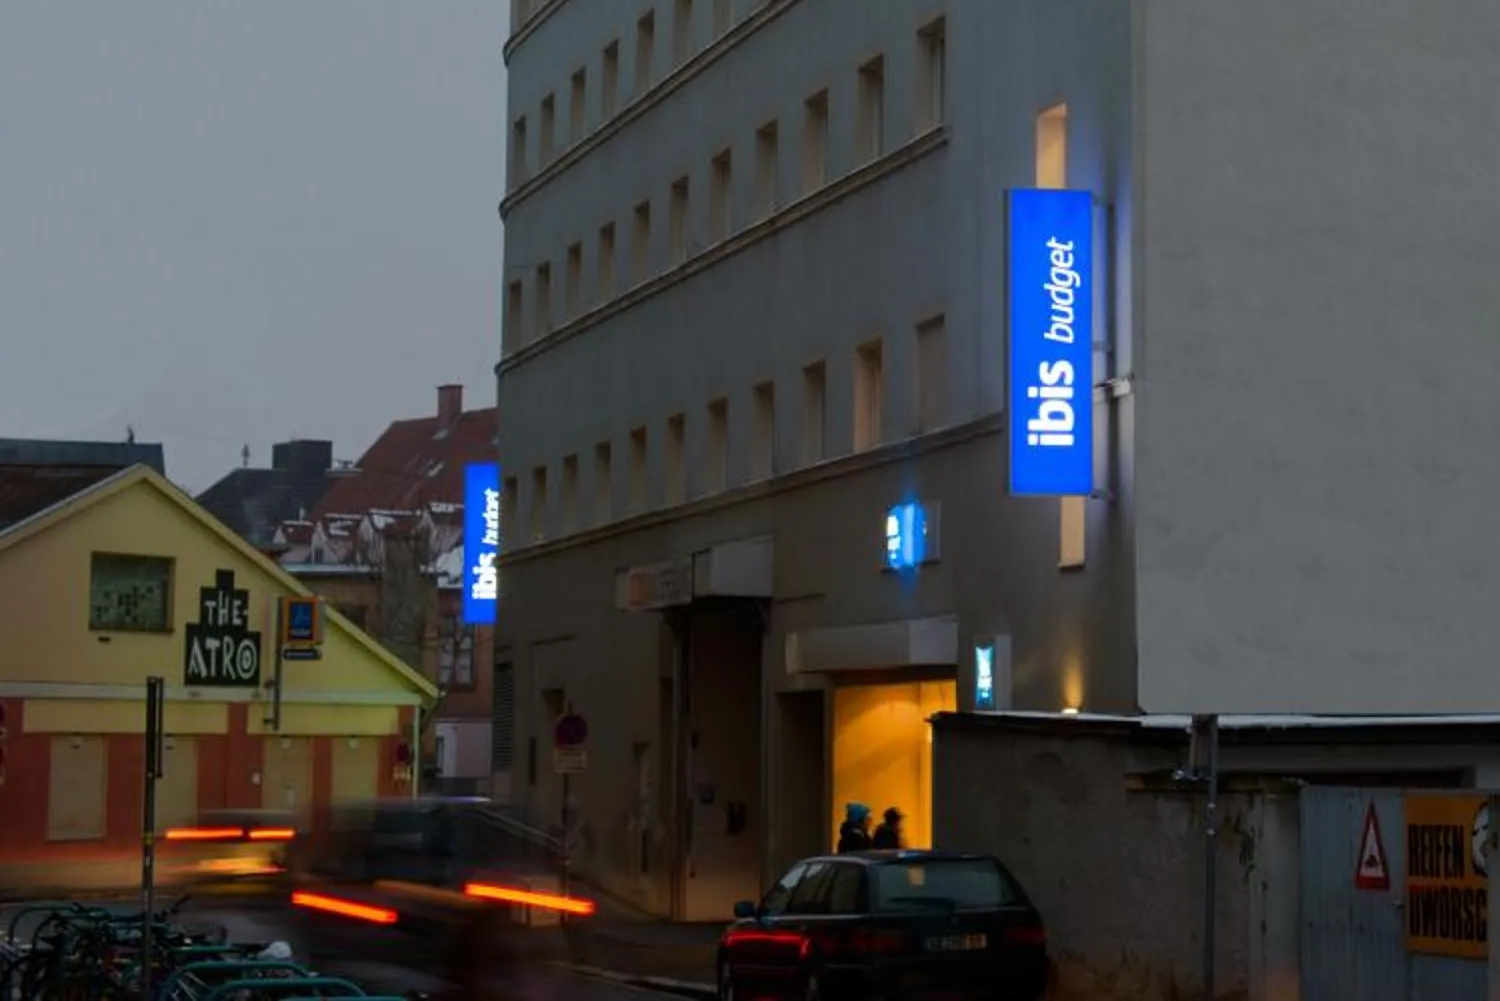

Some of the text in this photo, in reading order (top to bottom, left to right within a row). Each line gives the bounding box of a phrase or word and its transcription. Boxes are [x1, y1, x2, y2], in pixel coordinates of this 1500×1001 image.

[1028, 236, 1080, 446] ibis budget
[188, 635, 258, 680] ATRO
[1408, 824, 1465, 879] REIFEN
